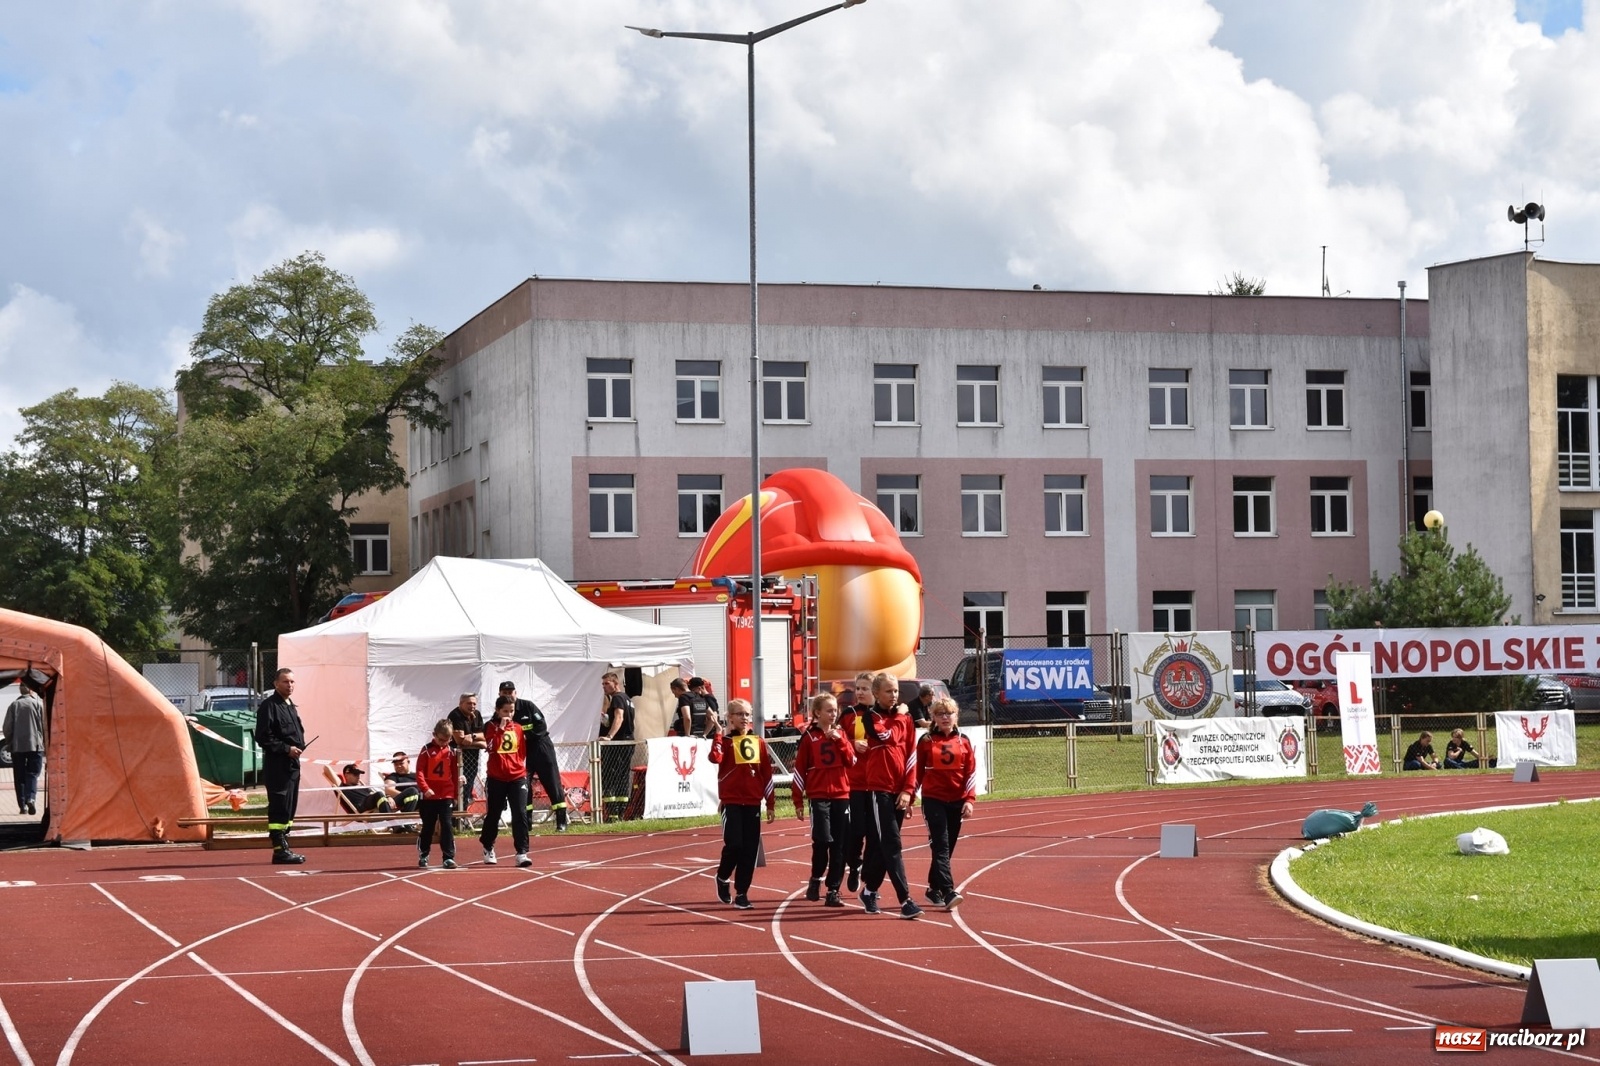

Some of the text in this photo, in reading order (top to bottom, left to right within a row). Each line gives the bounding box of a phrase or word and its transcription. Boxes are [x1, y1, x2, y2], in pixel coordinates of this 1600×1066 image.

[1064, 658, 1090, 666] środków
[1005, 666, 1092, 690] MSWiA
[501, 733, 513, 751] 8
[1220, 732, 1266, 742] OCHOTNICZYCH
[740, 738, 755, 761] 6
[819, 742, 836, 766] 5
[941, 744, 955, 765] 5
[1528, 742, 1542, 750] FHR
[1245, 754, 1275, 763] POLSKIEJ
[432, 761, 444, 778] 4
[678, 782, 691, 792] FHR
